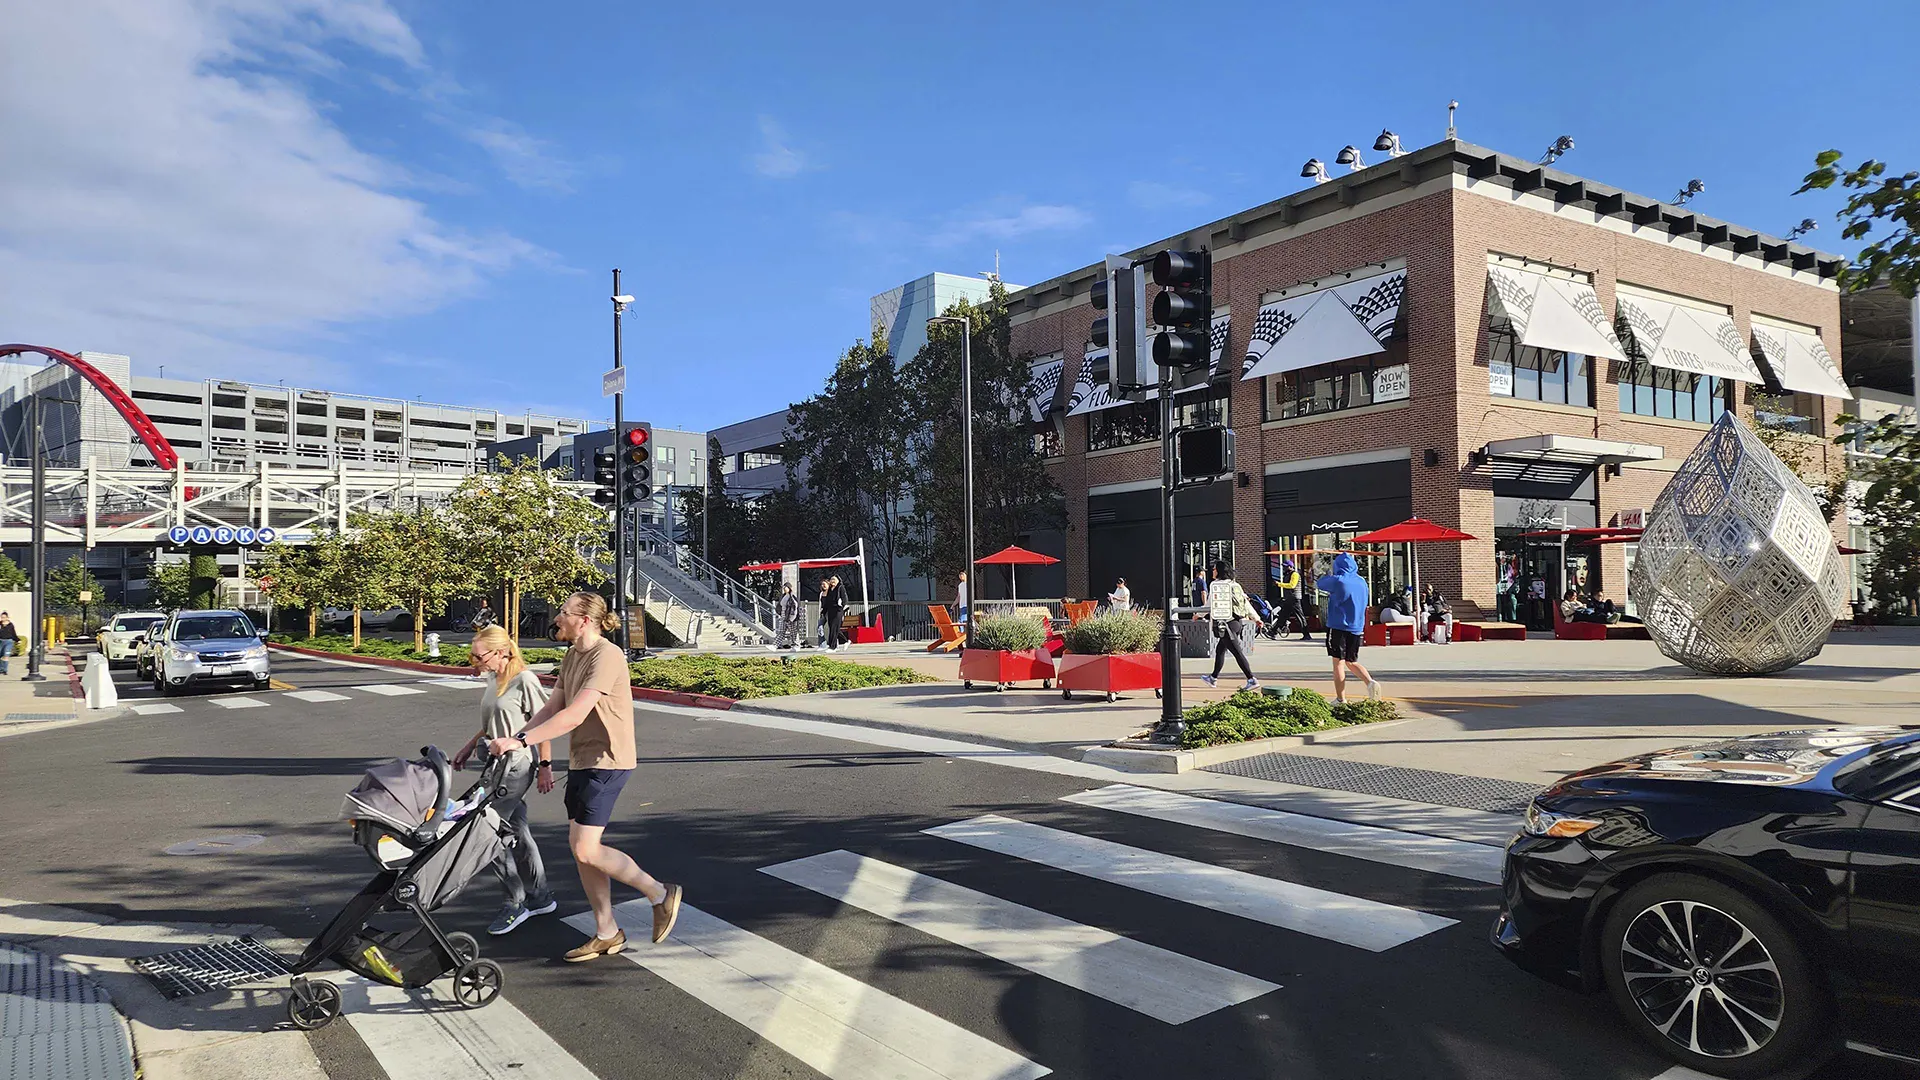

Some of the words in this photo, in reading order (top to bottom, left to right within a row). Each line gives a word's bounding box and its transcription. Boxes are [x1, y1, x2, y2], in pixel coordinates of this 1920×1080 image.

[1661, 346, 1704, 370] FLORES
[1490, 365, 1508, 375] NOW
[1381, 371, 1403, 383] NOW
[1489, 374, 1509, 386] OPEN
[1379, 380, 1406, 393] OPEN
[1311, 520, 1359, 531] MAC
[1529, 516, 1564, 526] MAC
[174, 527, 252, 542] PARK
